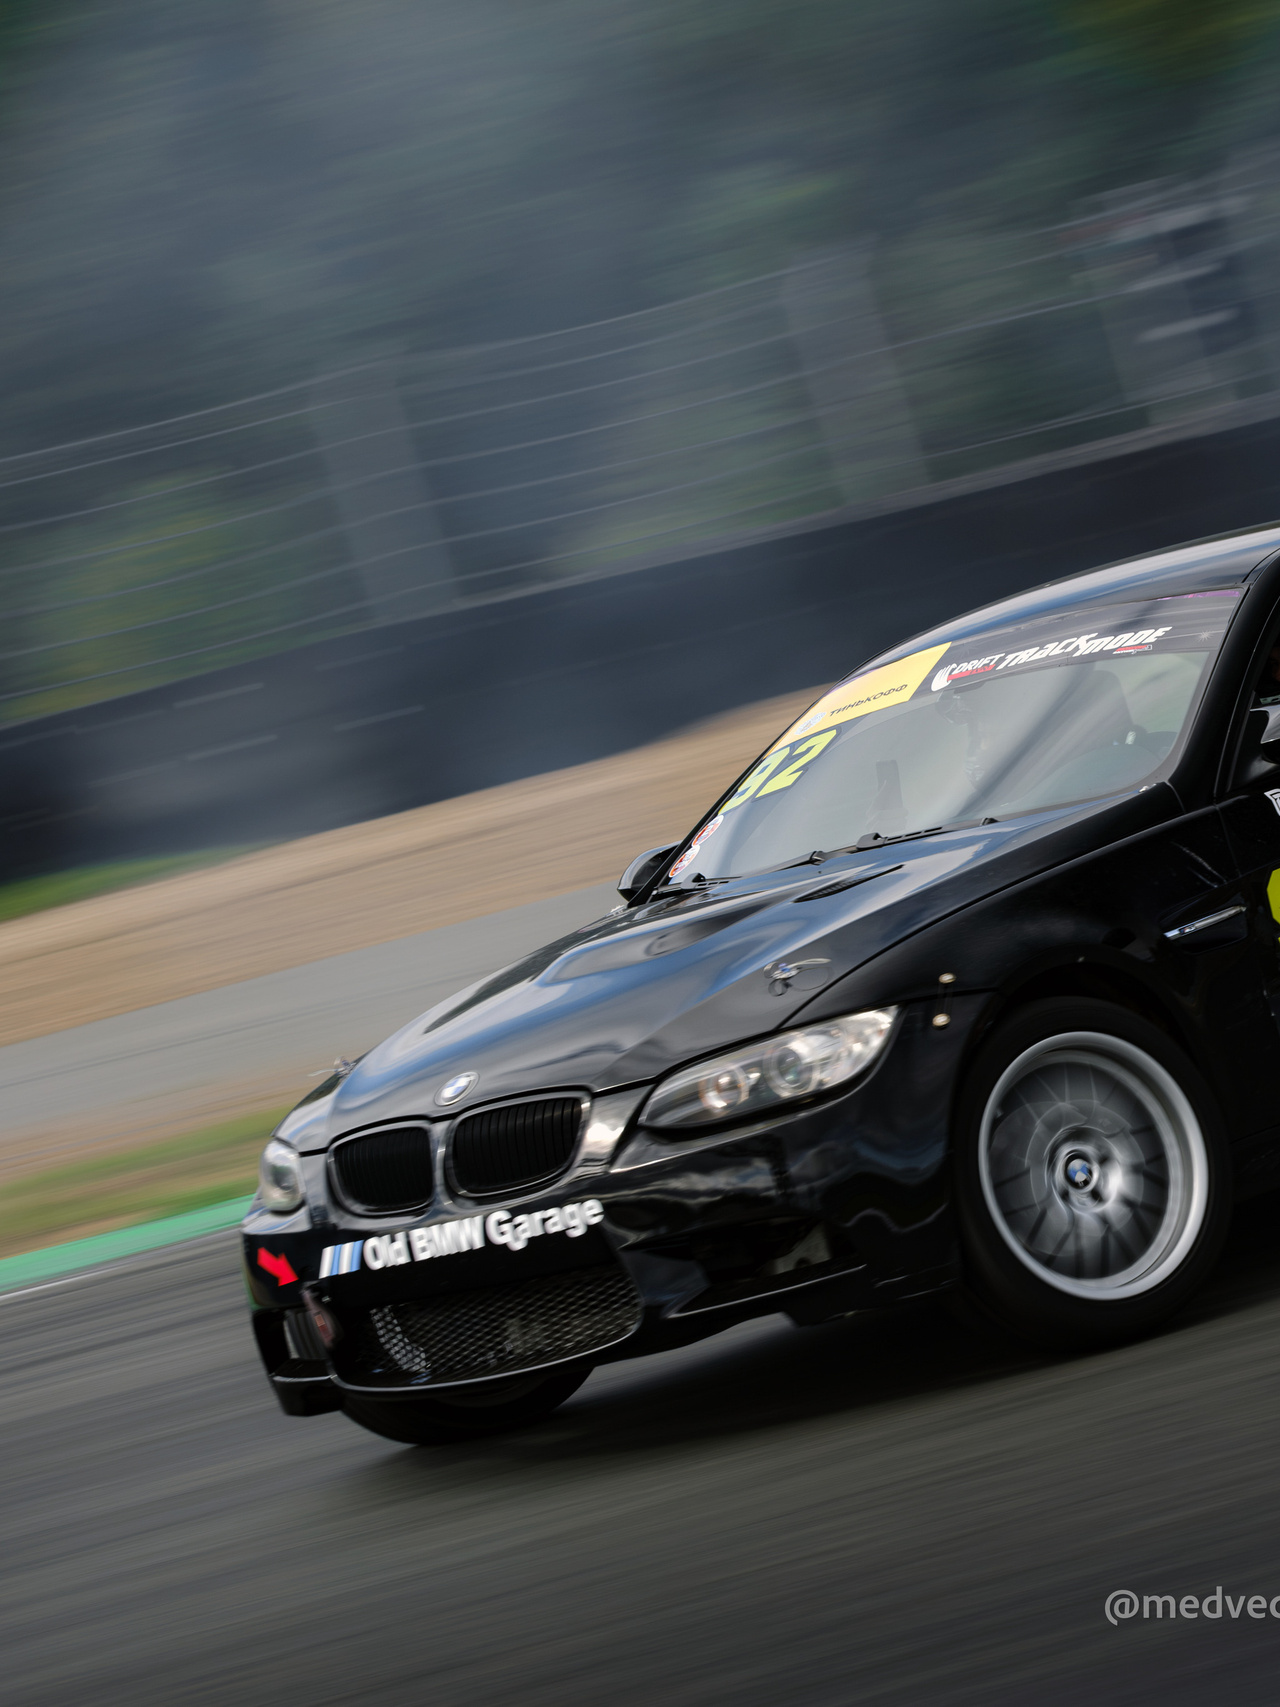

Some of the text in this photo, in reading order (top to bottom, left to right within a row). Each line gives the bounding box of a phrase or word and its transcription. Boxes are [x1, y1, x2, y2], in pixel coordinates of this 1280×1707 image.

[956, 652, 1005, 674] DRIFT
[718, 728, 837, 816] 92
[363, 1199, 605, 1271] Old BMW Garage
